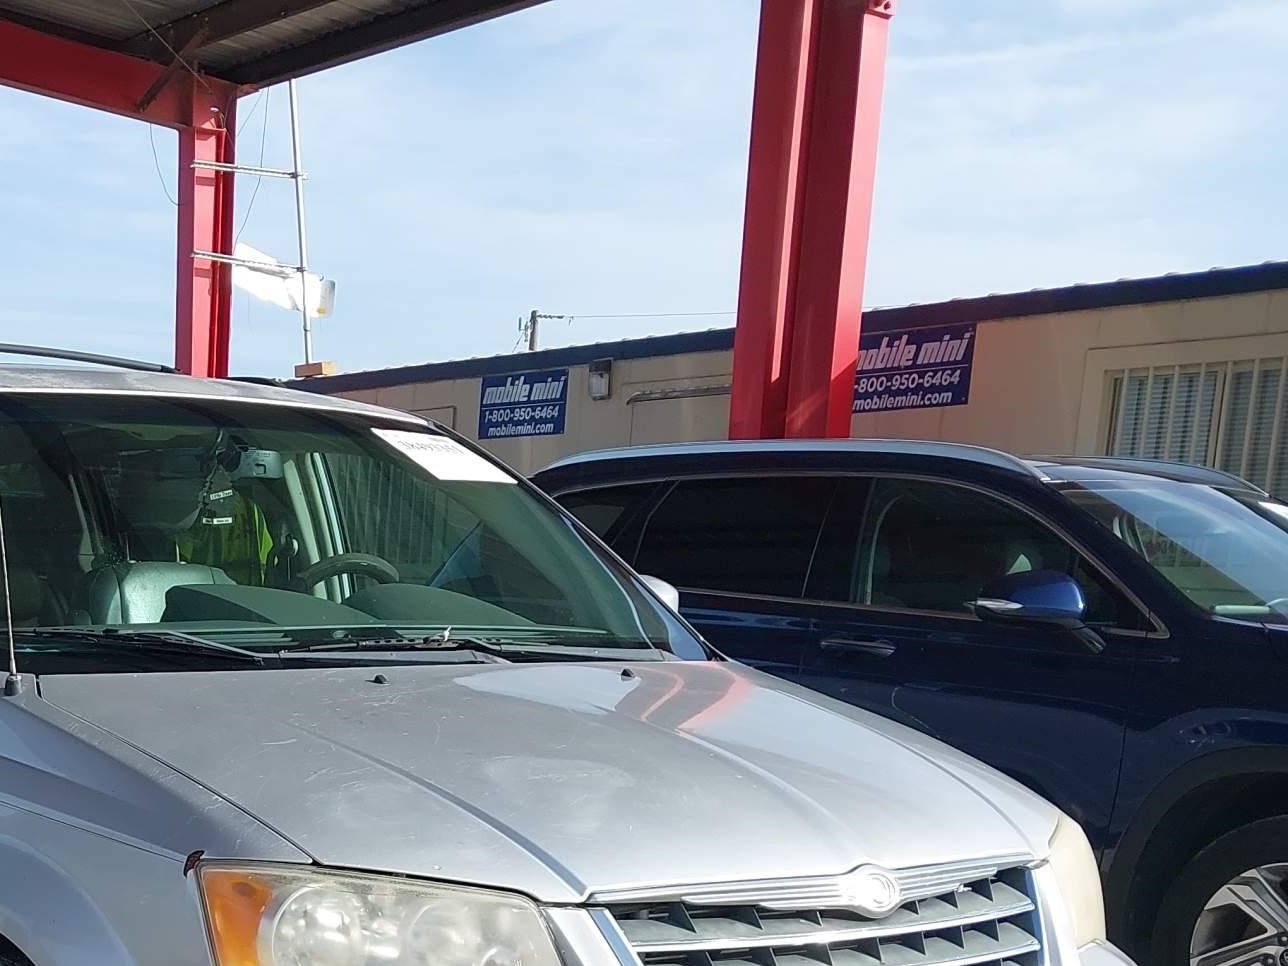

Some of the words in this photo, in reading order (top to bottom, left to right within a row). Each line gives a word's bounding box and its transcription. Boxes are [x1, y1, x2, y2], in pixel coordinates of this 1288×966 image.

[916, 333, 971, 364] mini
[483, 376, 530, 404] mobile
[530, 376, 567, 401] mini
[853, 370, 960, 392] -800-950-6464
[852, 391, 952, 410] mobilemini.com
[485, 405, 559, 423] 1-800-950-6464
[488, 422, 554, 436] mobilemini.com
